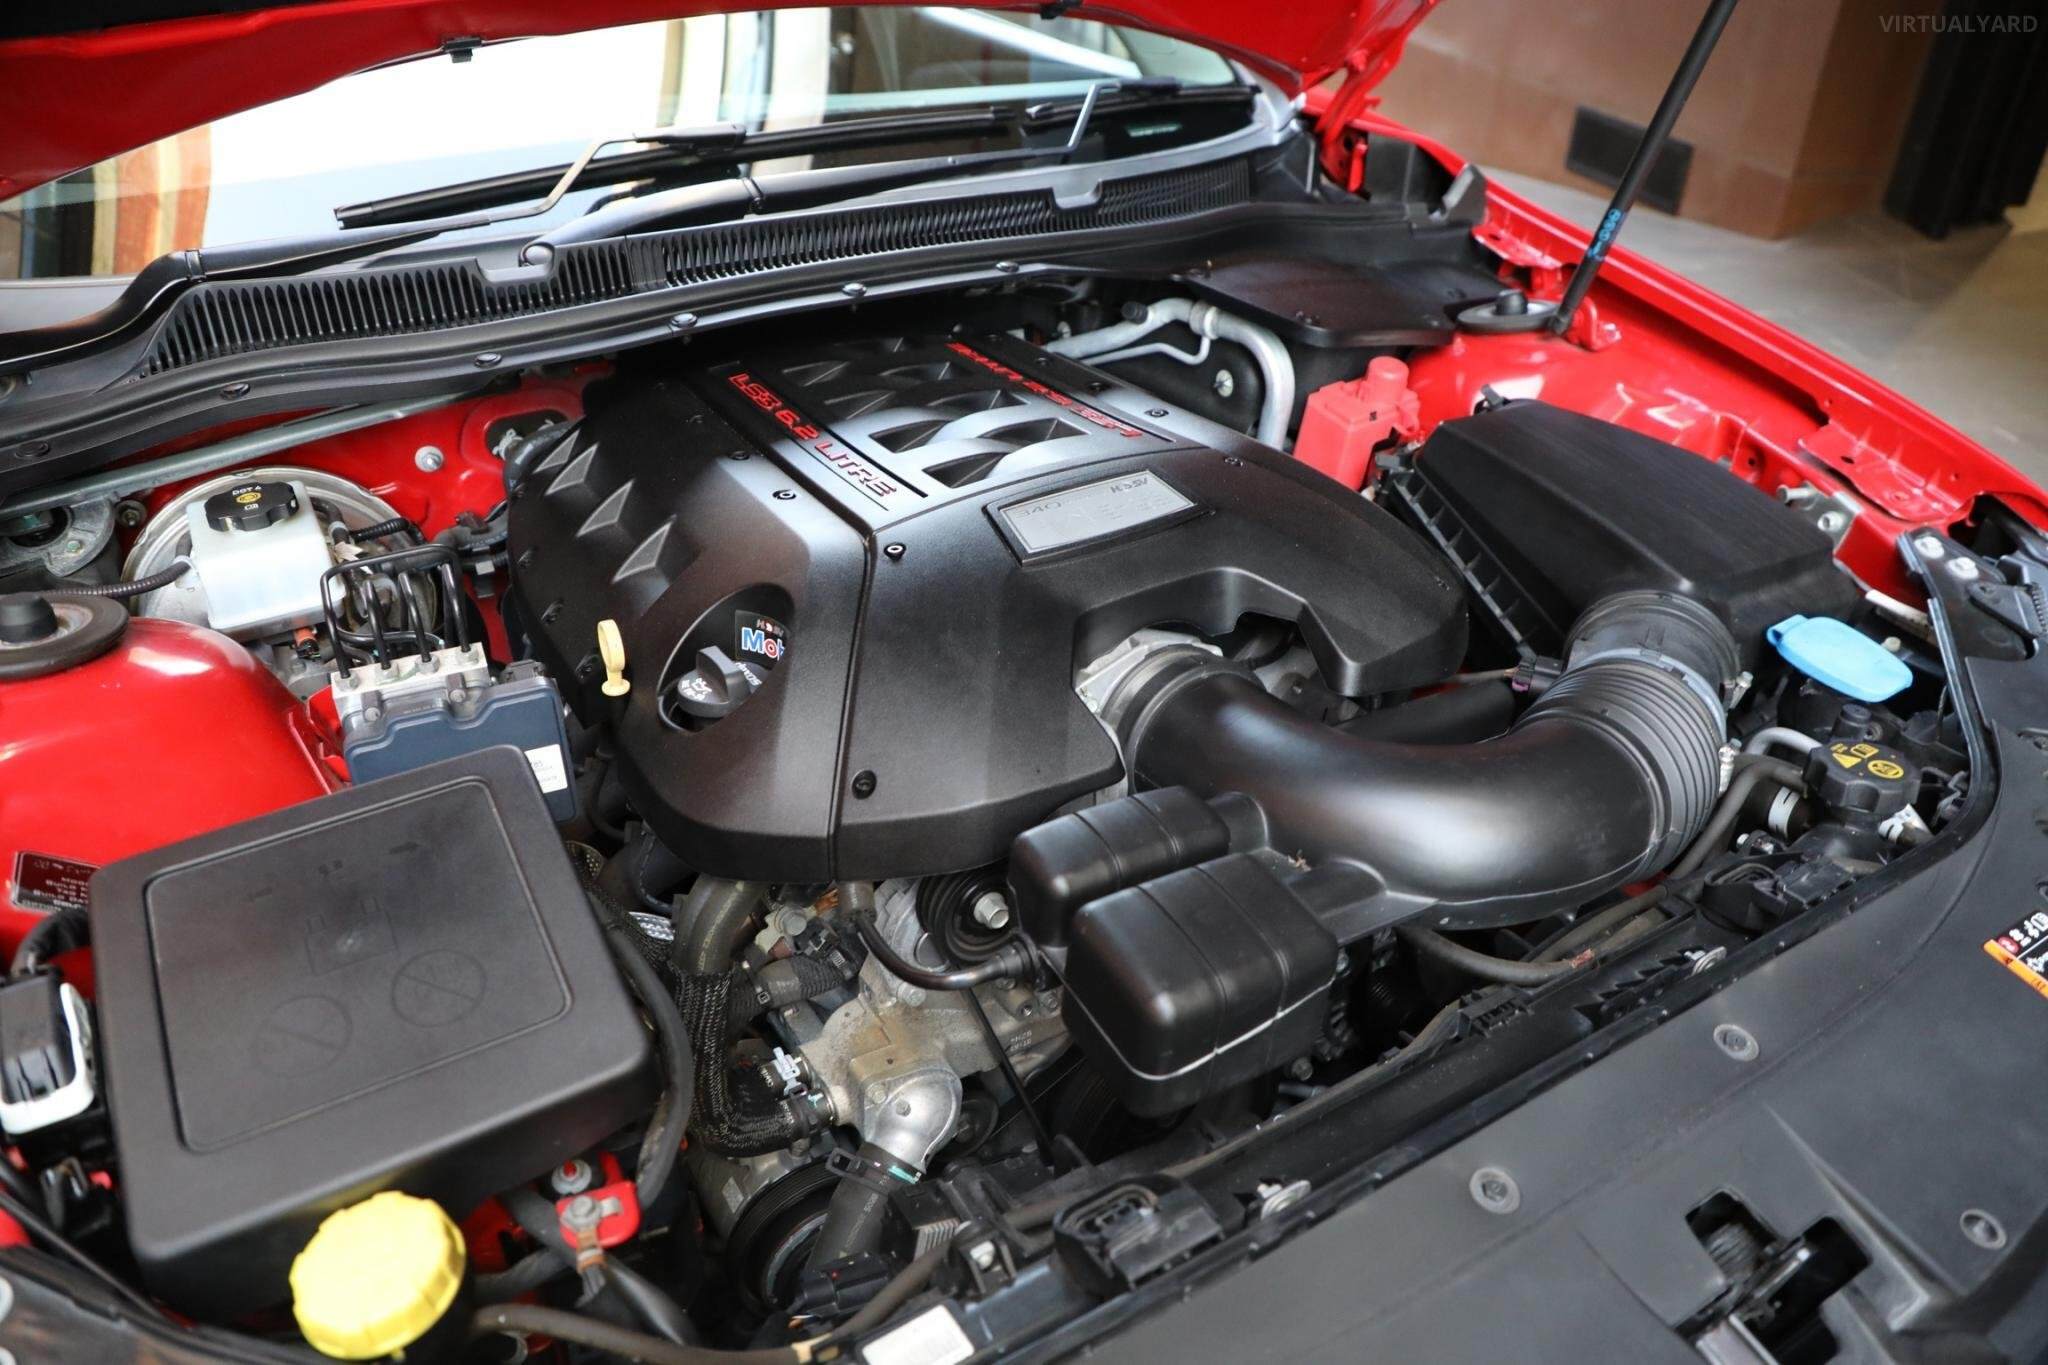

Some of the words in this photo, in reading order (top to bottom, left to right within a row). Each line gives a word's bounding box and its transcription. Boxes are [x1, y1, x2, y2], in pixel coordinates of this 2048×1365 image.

[728, 373, 782, 412] LS3
[775, 409, 820, 440] 6.2
[815, 440, 897, 497] LITRE
[232, 487, 253, 496] DOT
